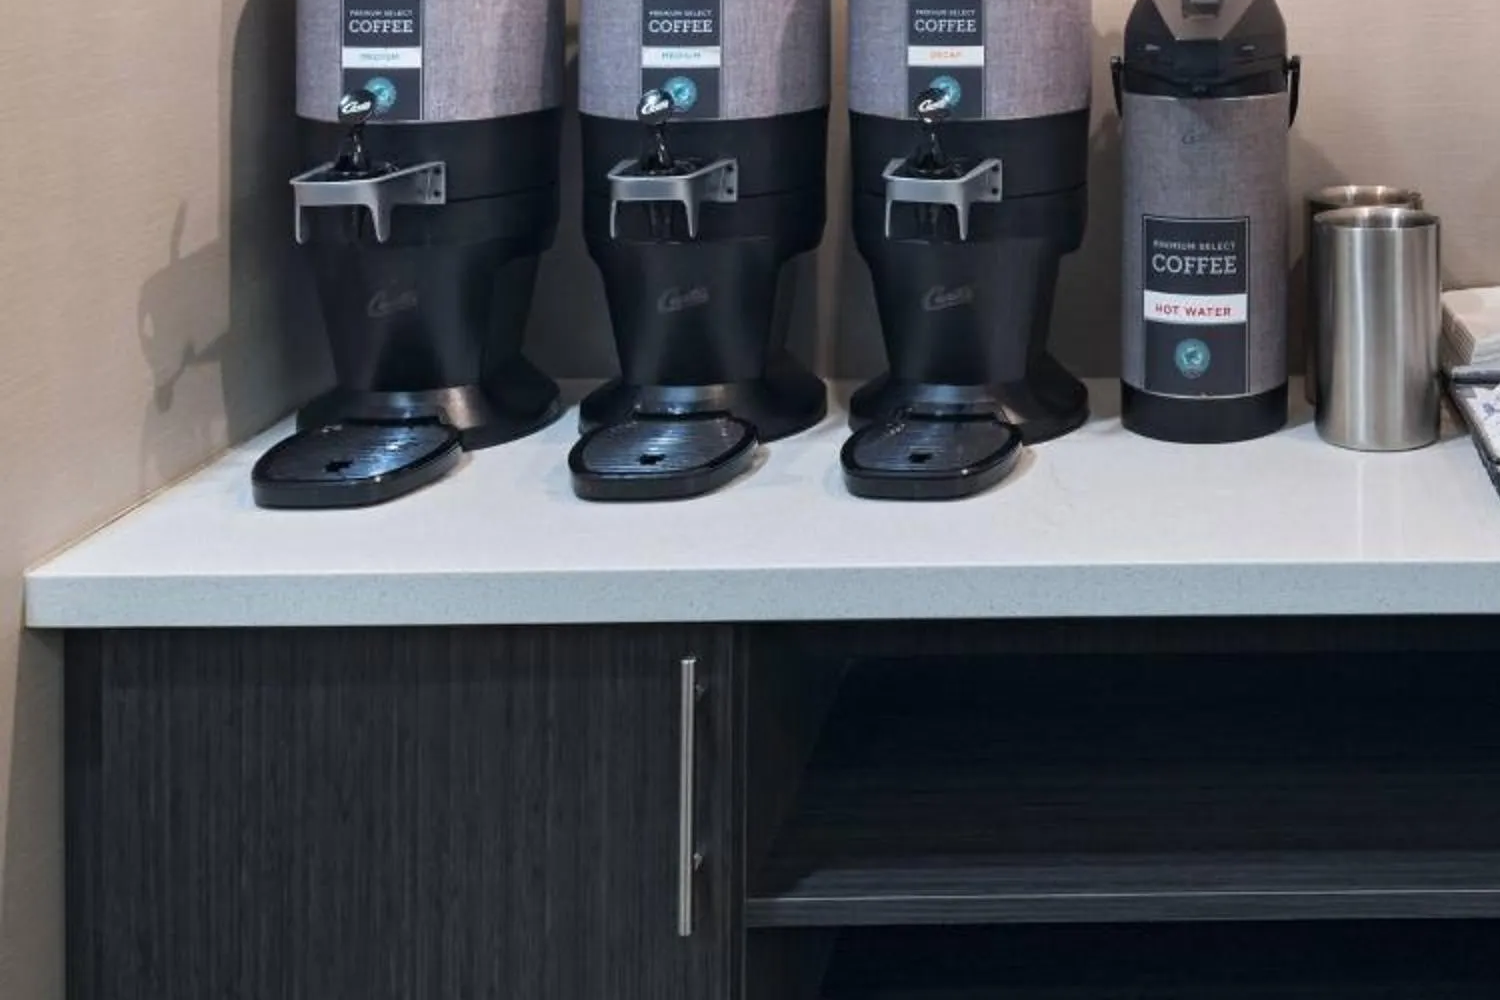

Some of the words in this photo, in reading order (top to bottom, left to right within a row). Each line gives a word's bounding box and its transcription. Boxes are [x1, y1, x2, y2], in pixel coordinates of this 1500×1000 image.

[349, 19, 413, 33] COFFEE
[648, 19, 713, 33] COFFEE
[914, 19, 977, 33] COFFEE
[1153, 239, 1196, 250] PREMIUM
[1199, 240, 1236, 250] SELECT
[1152, 253, 1237, 275] COFFEE
[1155, 303, 1179, 315] HOT
[1184, 306, 1232, 317] WATER
